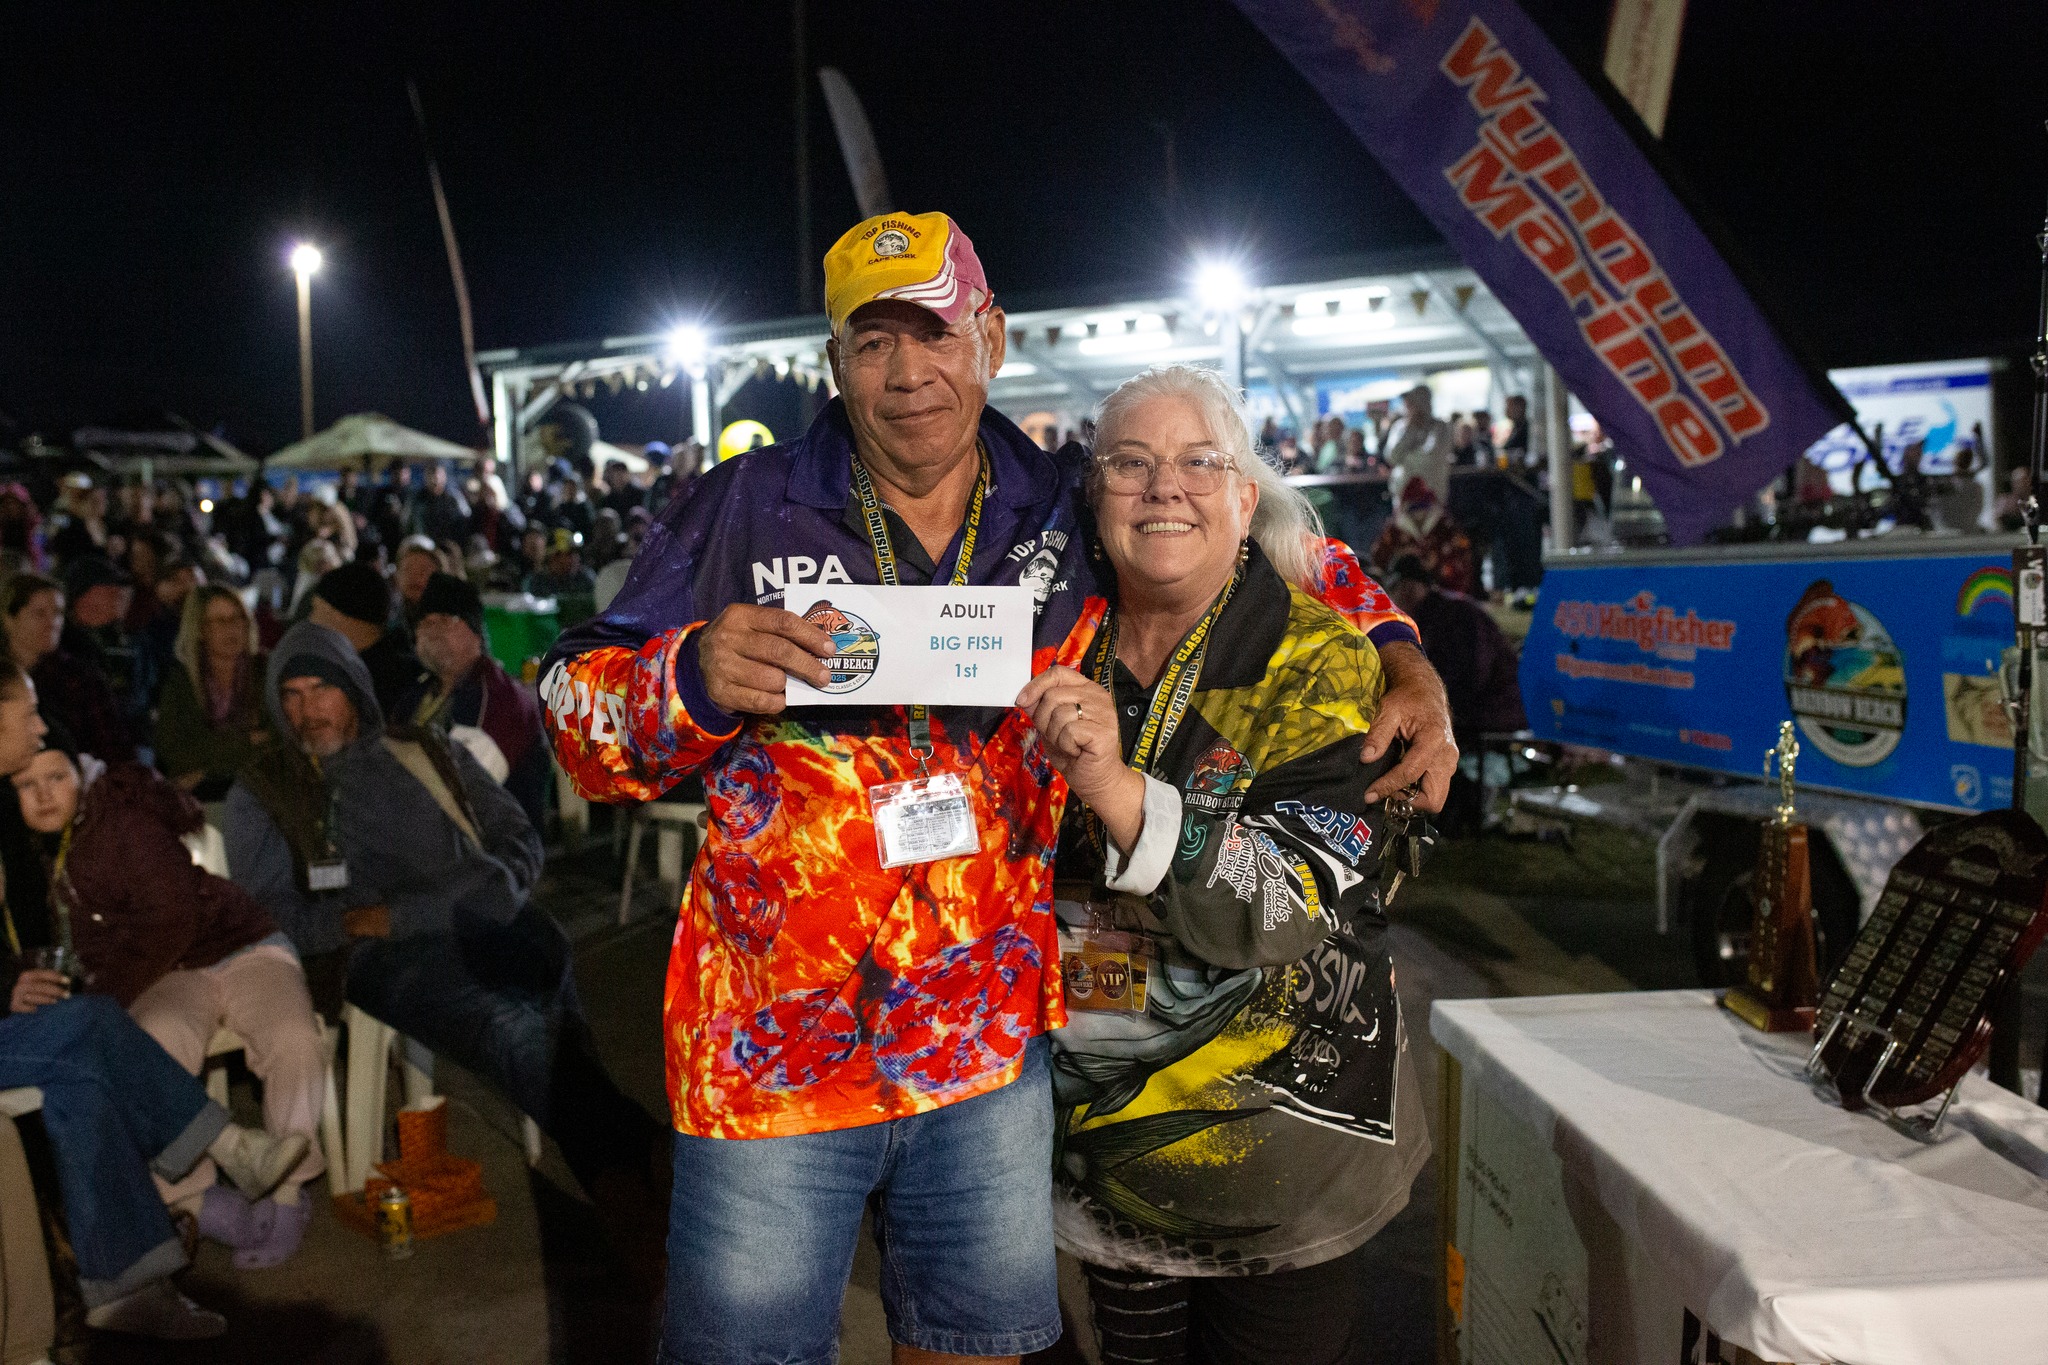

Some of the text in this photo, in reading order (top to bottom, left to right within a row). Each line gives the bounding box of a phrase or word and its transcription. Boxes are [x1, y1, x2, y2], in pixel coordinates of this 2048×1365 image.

[860, 220, 922, 241] TOP FISHING
[1440, 15, 1770, 445] Wynnum
[868, 256, 890, 265] CAPE
[1442, 142, 1724, 469] Marine
[854, 464, 877, 510] CLASSIC
[868, 510, 890, 559] FISHING
[958, 527, 977, 575] FISHING
[970, 480, 986, 526] CLASSIC
[1004, 530, 1069, 562] TOP FISHI
[752, 555, 854, 596] NPA
[757, 591, 785, 606] NORTHER
[940, 604, 996, 619] ADULT
[843, 658, 874, 670] BEACH
[930, 636, 1003, 651] BIG FISH
[831, 674, 847, 682] 025
[954, 663, 978, 678] 1st
[1134, 616, 1211, 765] FAMILY FISHING CLASSIC
[1170, 662, 1199, 715] FISHING
[1220, 839, 1242, 880] Blinds
[1263, 880, 1276, 931] Queensland
[1293, 863, 1320, 921] HIRE
[1101, 973, 1125, 985] VIP
